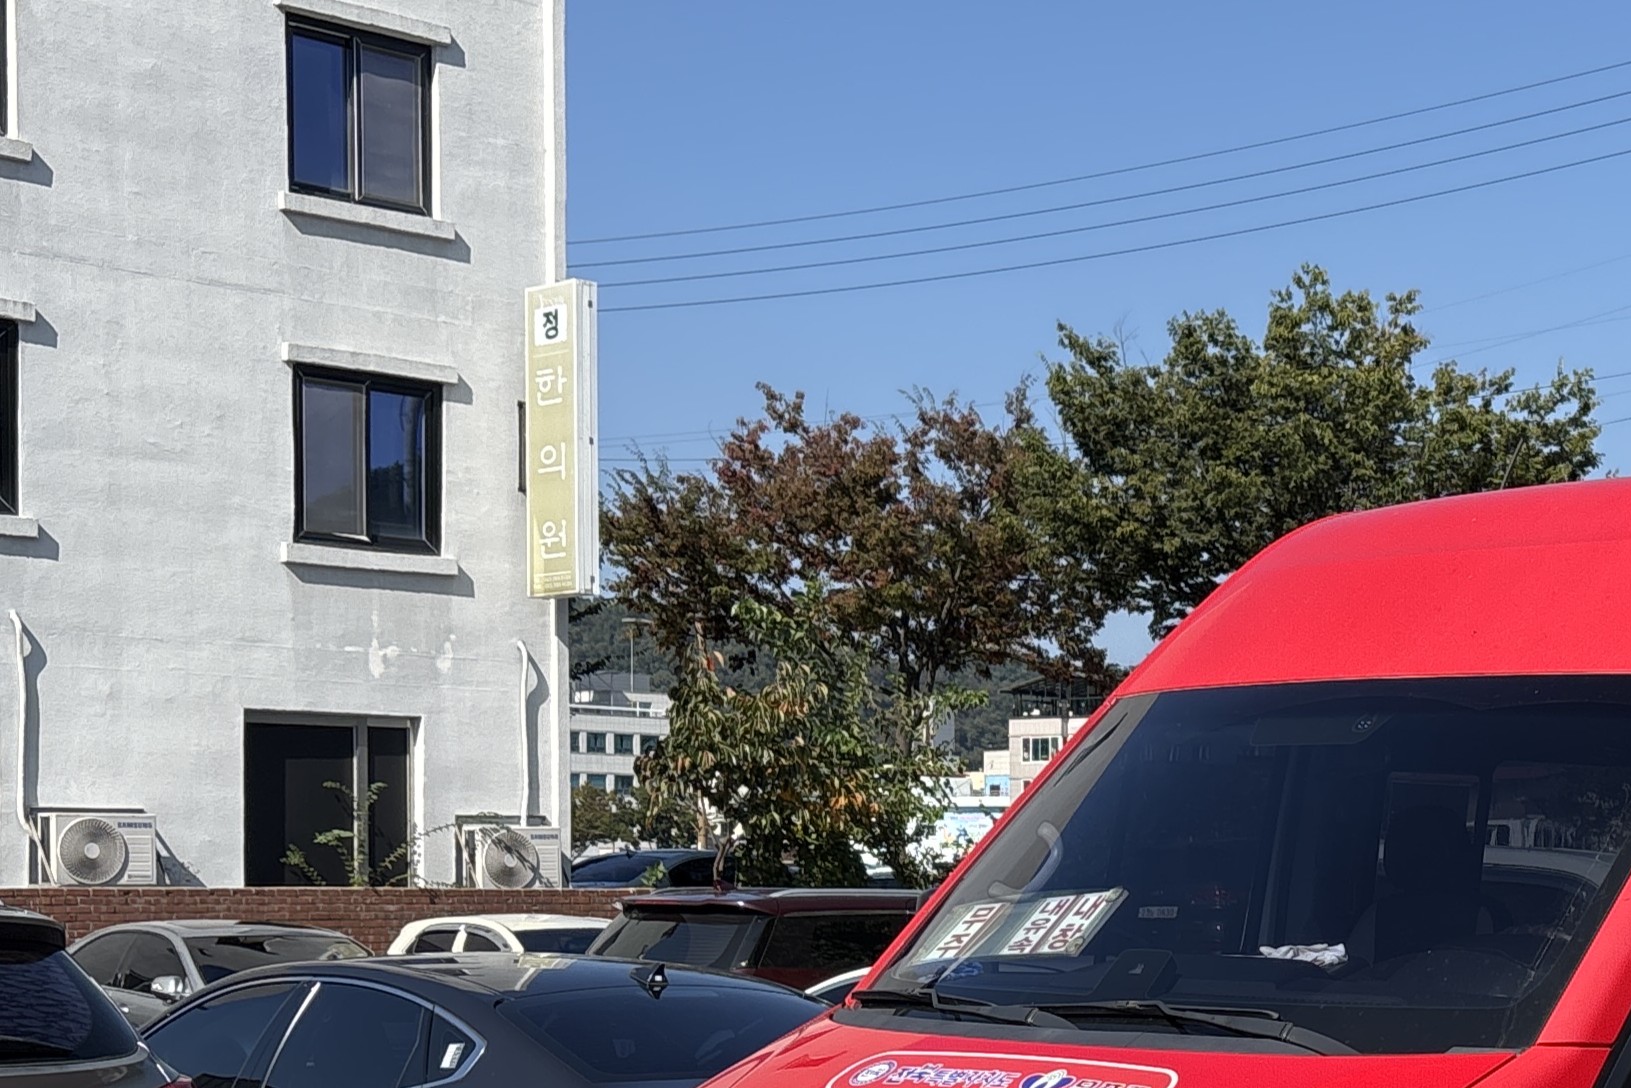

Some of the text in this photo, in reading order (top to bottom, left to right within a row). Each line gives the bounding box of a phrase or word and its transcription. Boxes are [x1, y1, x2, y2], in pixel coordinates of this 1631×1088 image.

[542, 308, 559, 340] 정
[535, 365, 567, 560] 한의원
[936, 906, 993, 958] 무주
